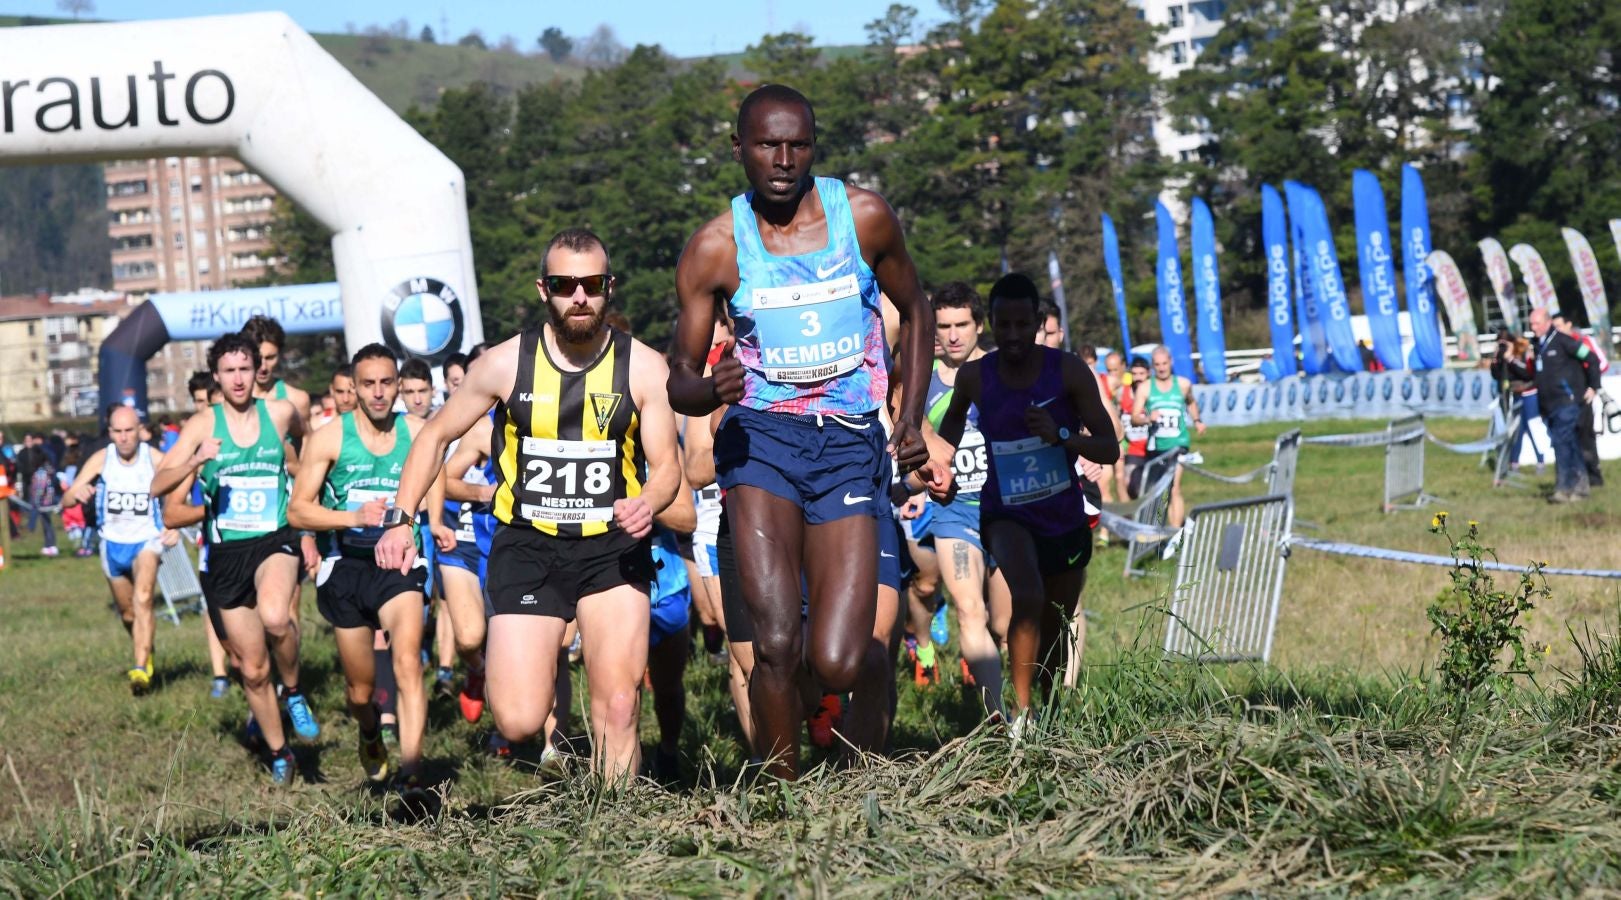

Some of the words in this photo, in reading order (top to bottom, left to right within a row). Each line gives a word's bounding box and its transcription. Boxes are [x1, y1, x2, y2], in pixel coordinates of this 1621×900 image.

[2, 60, 235, 133] rauto
[384, 278, 456, 311] BMW
[799, 311, 822, 337] 3
[765, 333, 861, 365] KEMBOI
[777, 371, 787, 380] 63
[811, 364, 838, 379] KROSA
[950, 446, 988, 475] 08
[1023, 455, 1039, 472] 2
[525, 459, 611, 495] 218
[1010, 470, 1060, 493] HAJI
[108, 492, 148, 511] 205
[230, 490, 266, 513] 69
[541, 497, 594, 508] NESTOR
[531, 509, 541, 518] 63
[561, 512, 586, 520] KROSA
